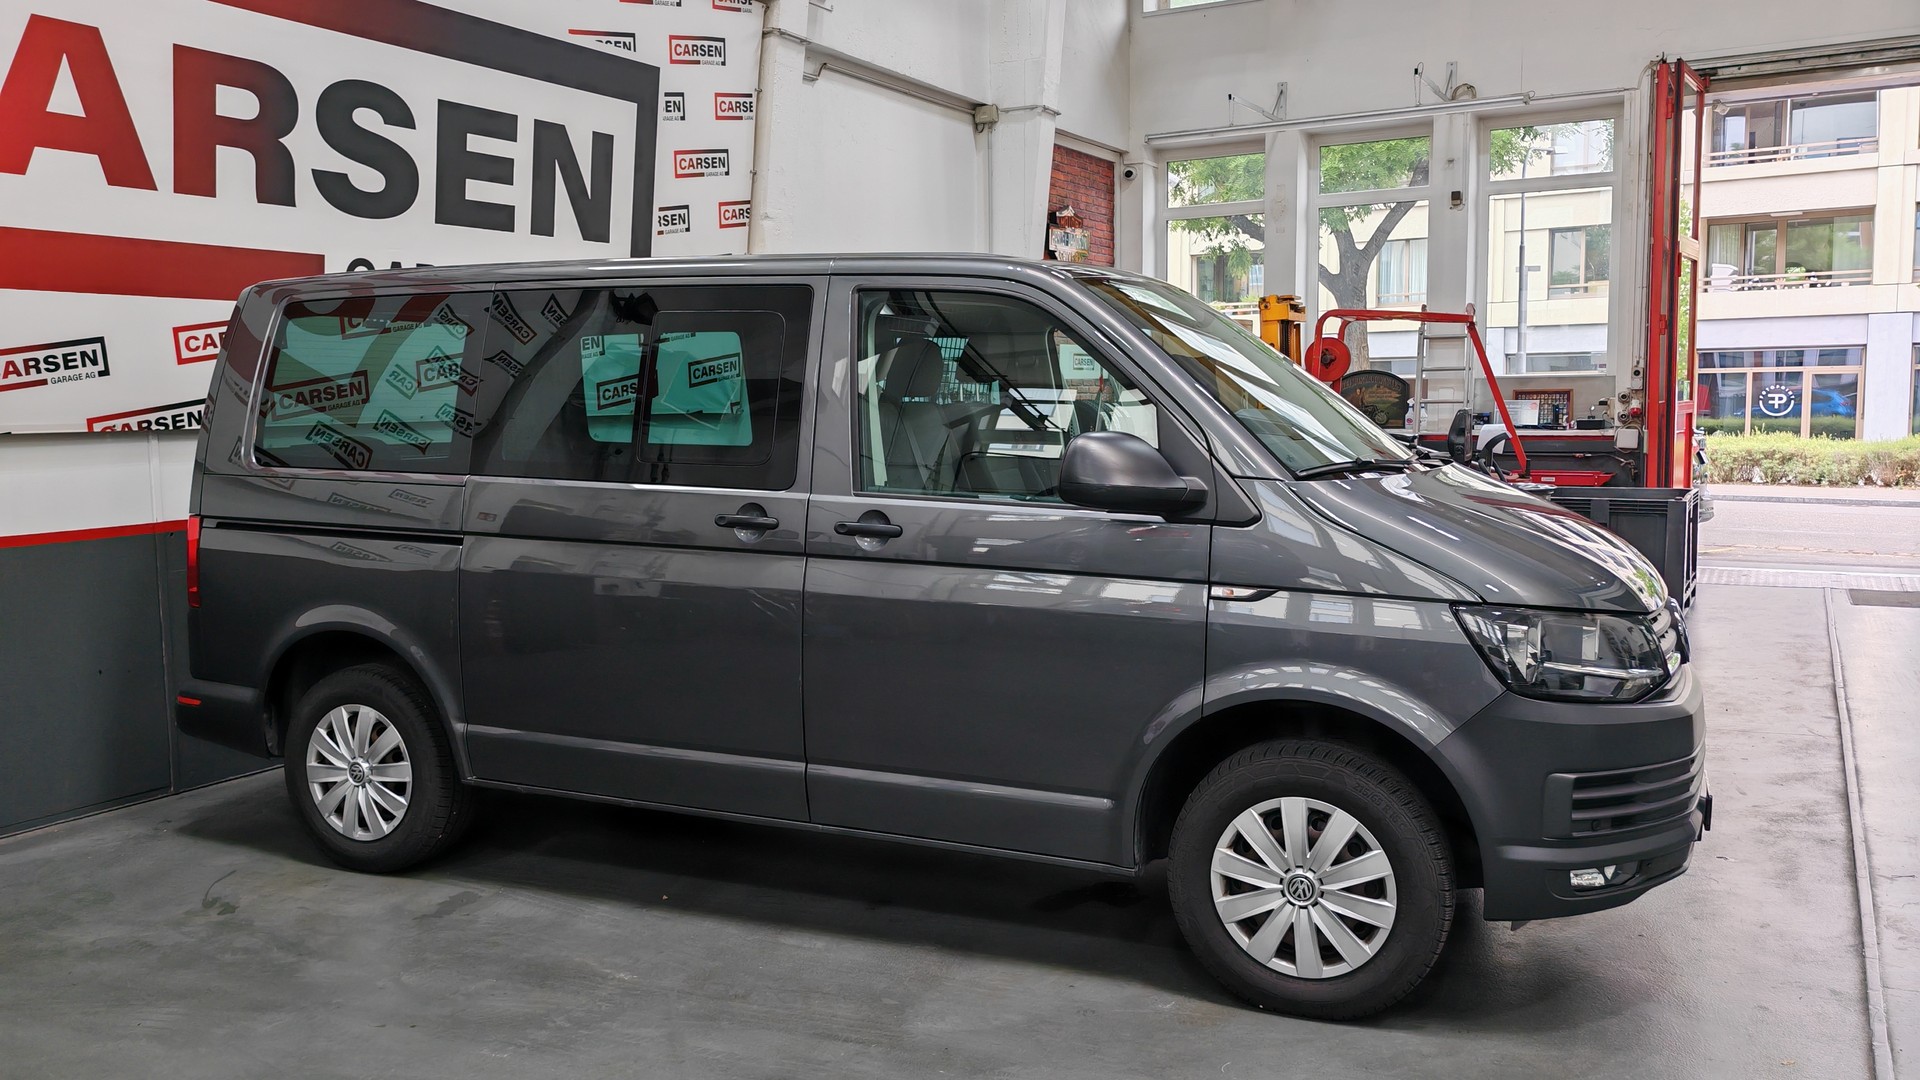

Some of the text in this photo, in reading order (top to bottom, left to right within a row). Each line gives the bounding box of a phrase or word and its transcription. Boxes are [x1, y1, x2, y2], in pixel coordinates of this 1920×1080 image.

[674, 43, 722, 58] CARSEN
[679, 156, 726, 170] CARSEN
[692, 360, 737, 380] CARSEN
[50, 371, 96, 385] GARAGE AG
[279, 380, 363, 409] CARSEN
[327, 400, 351, 411] GARAGE
